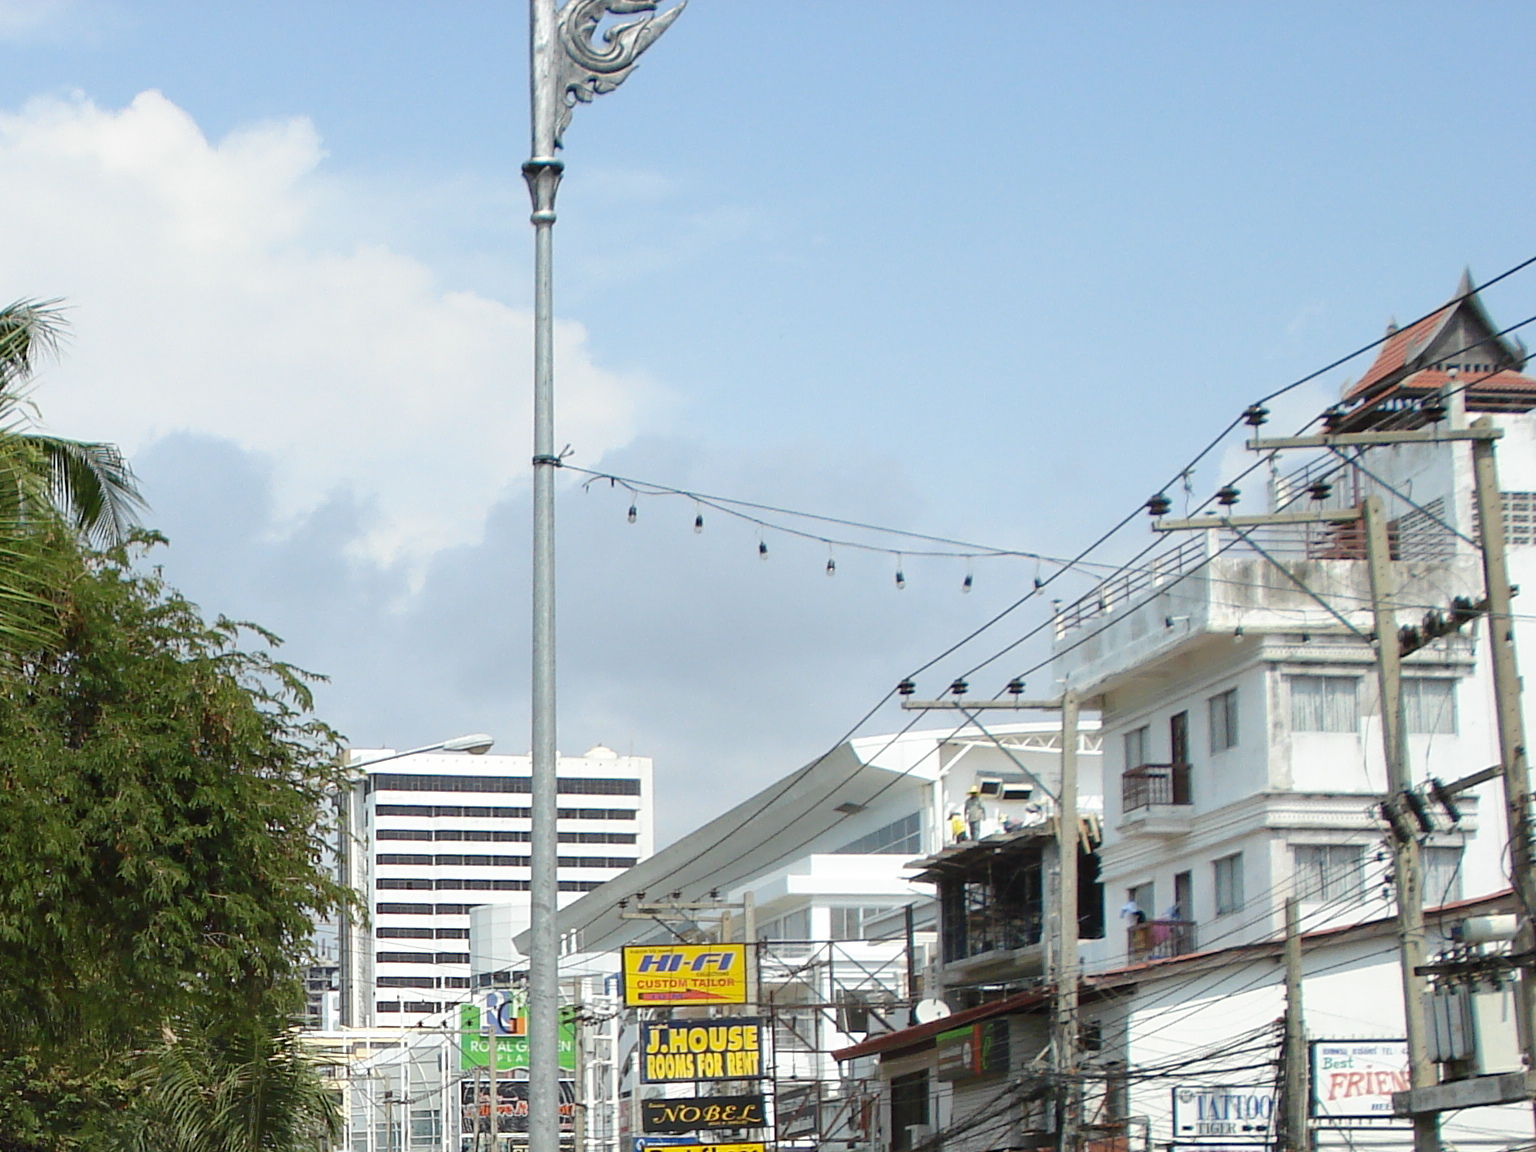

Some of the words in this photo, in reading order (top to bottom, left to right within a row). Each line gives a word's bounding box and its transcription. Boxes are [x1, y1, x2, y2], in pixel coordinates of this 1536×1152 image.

[637, 952, 735, 973] HI-FI
[636, 979, 688, 989] CUSTOM
[691, 978, 735, 987] TAILOR
[470, 1040, 513, 1052] ROAL
[646, 1024, 759, 1054] J.HOUSE
[647, 1053, 695, 1080] ROOMS
[697, 1052, 724, 1078] FOR
[727, 1051, 760, 1077] RENT
[1321, 1057, 1354, 1070] Best
[1327, 1065, 1411, 1101] FRIEN
[652, 1103, 762, 1125] NOBEL
[1197, 1095, 1272, 1120] TATTOO
[1196, 1123, 1237, 1134] TIGER
